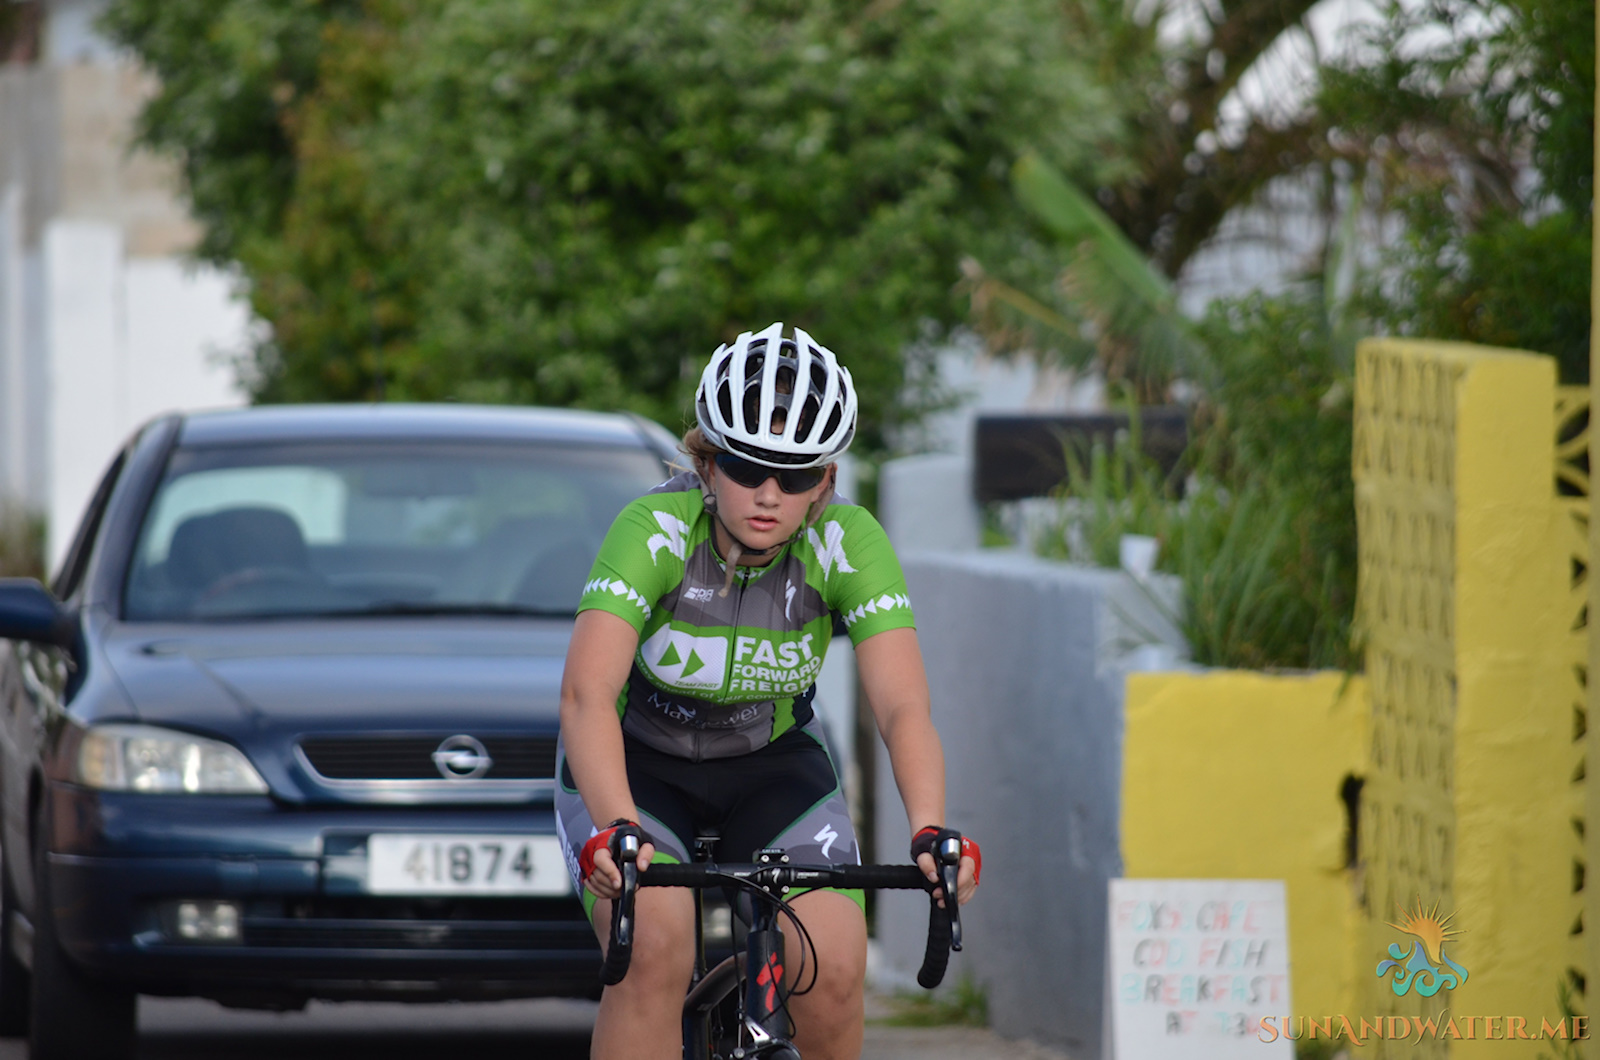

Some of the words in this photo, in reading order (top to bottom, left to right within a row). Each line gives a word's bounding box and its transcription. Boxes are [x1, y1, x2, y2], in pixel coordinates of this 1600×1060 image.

[734, 633, 813, 668] FAST
[732, 656, 821, 682] FORWARD
[403, 842, 534, 883] 41874
[1133, 938, 1187, 968] COD
[1198, 938, 1270, 968] FISH
[1119, 973, 1286, 1006] BREAKFAST
